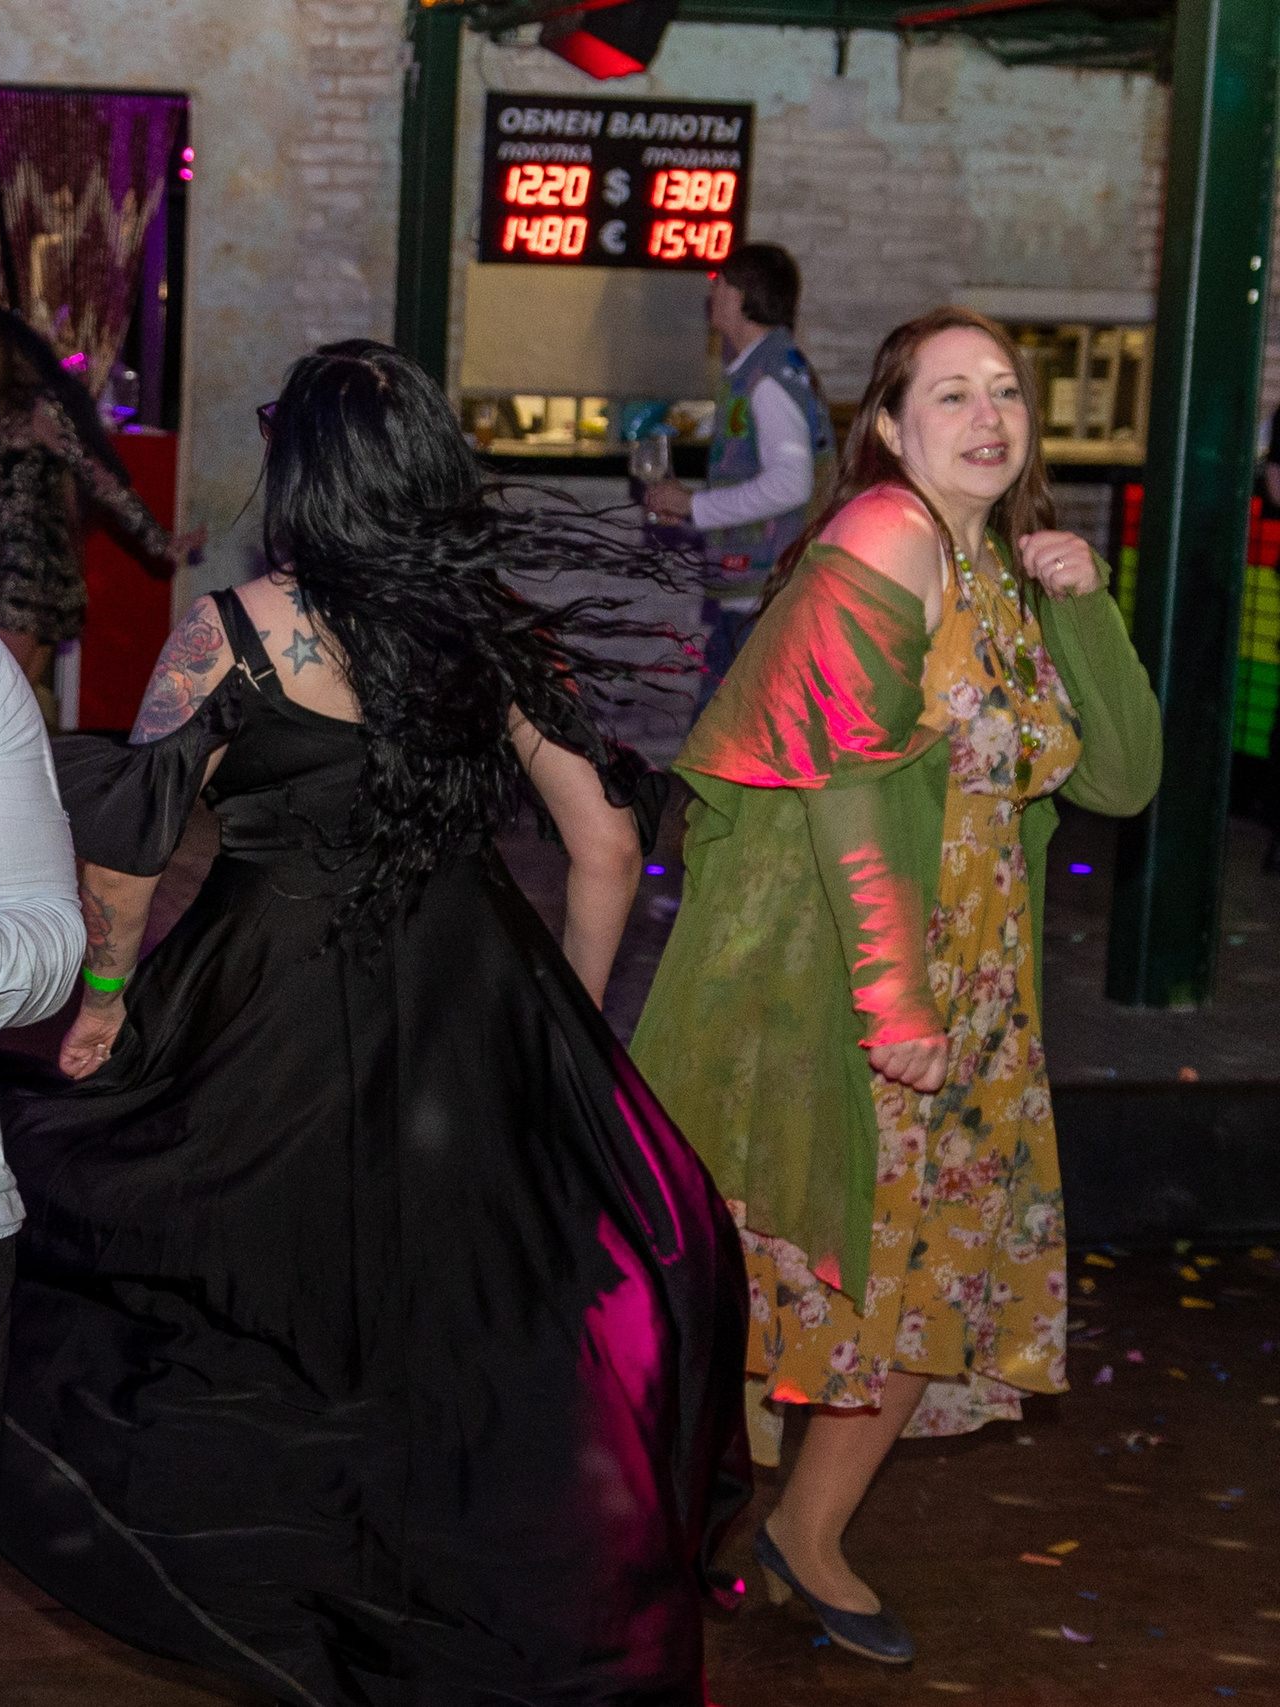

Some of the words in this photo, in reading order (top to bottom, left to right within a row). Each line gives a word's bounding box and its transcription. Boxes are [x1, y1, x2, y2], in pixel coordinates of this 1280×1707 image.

[498, 107, 603, 137] ОБМЕН
[606, 111, 743, 143] ВАЛЮТЫ
[497, 141, 592, 163] ПОКУПКА
[641, 147, 741, 169] ПРОДАЖА
